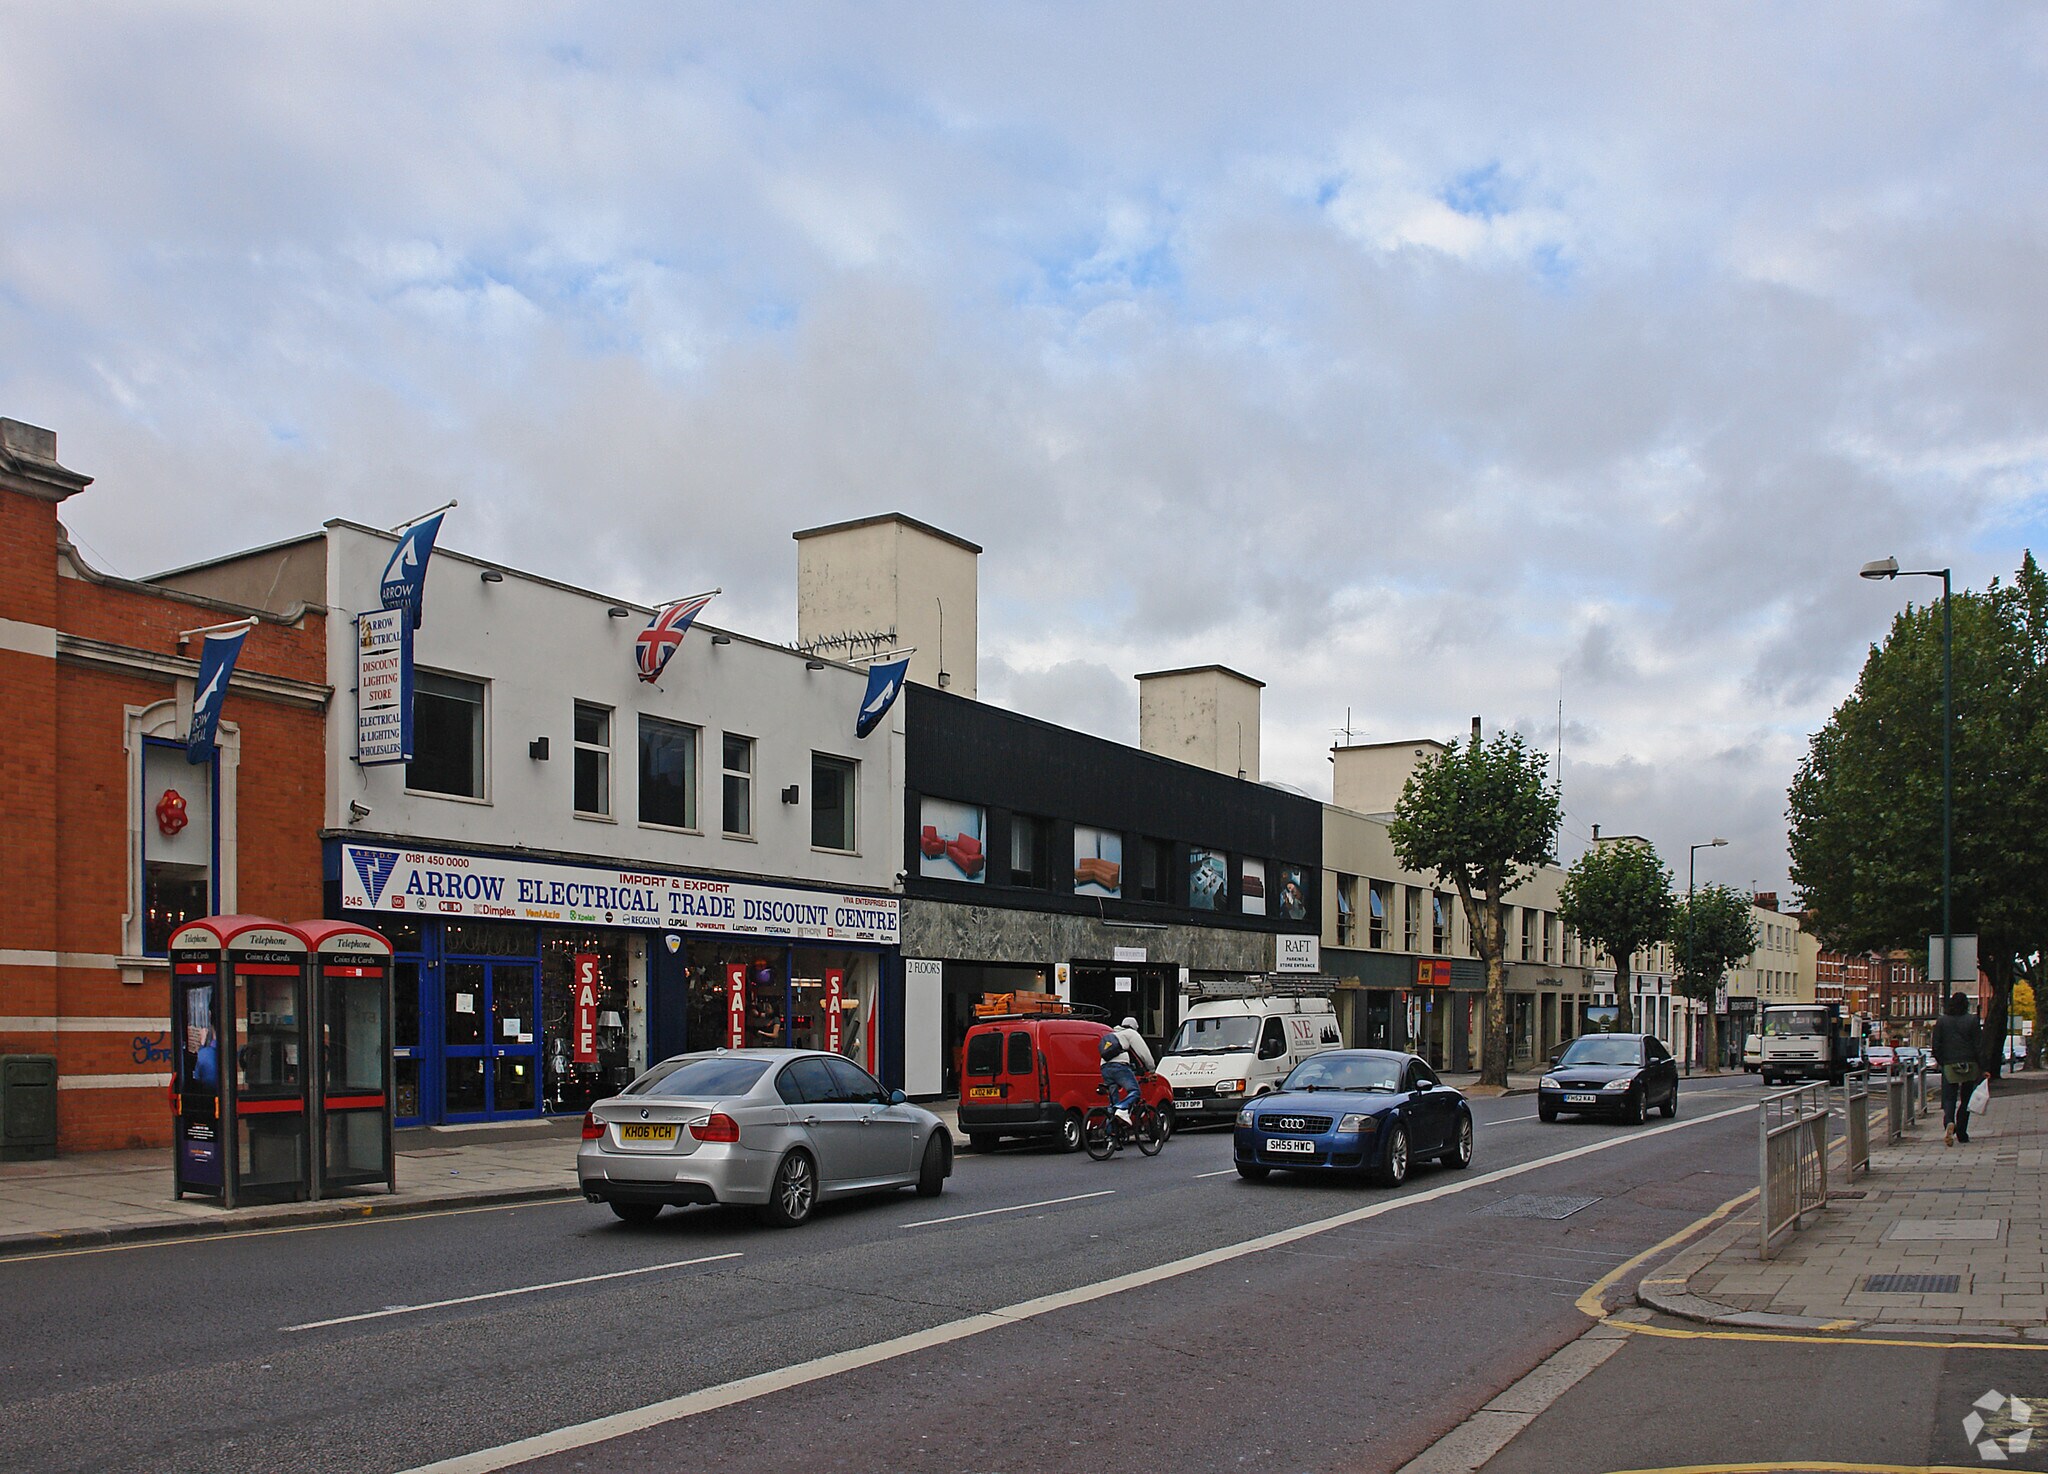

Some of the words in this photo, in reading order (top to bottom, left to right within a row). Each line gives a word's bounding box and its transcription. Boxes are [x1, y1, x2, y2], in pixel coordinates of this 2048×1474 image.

[383, 584, 414, 600] ARROW
[367, 617, 394, 630] ARROW
[360, 632, 401, 647] ELECTRICAL
[363, 658, 398, 672] DISCOUNT
[363, 673, 398, 687] LIGHTING
[369, 689, 392, 701] STORE
[360, 712, 400, 727] ELECTRICAL
[361, 732, 366, 742] &
[367, 728, 400, 742] LIGHTING
[360, 743, 401, 756] WHOLESALERS
[405, 853, 425, 864] 0181
[427, 855, 444, 865] 450
[446, 857, 469, 868] 0000
[619, 873, 667, 888] IMPORT
[671, 879, 680, 889] &
[684, 880, 730, 894] EXPORT
[344, 896, 363, 907] 245
[405, 870, 505, 901] ARROW
[517, 878, 659, 913] ELECTRICAL
[668, 892, 735, 919] TRADE
[743, 899, 828, 926] DISCOUNT
[835, 907, 897, 931] CENTRE
[842, 896, 855, 904] VIVA
[855, 897, 888, 908] ENTERPRISES
[888, 900, 897, 908] LTD
[483, 904, 516, 917] Dimplex
[631, 915, 661, 926] REGGIANI
[696, 922, 726, 930] POWERLITE
[732, 923, 758, 933] Lumiance
[184, 934, 208, 945] Telephone
[250, 935, 287, 946] Telephone
[337, 938, 371, 949] Telephone
[1285, 940, 1311, 952] RAFT
[245, 952, 263, 961] Coins
[264, 953, 271, 961] &
[271, 953, 290, 962] Cards
[333, 955, 350, 964] Coins
[350, 956, 357, 964] &
[357, 956, 375, 965] Cards
[908, 961, 913, 973] 2
[914, 962, 941, 974] FLOORS
[580, 962, 595, 1053] SALE
[731, 971, 744, 1049] SALE
[829, 976, 841, 1052] SALE
[250, 1011, 272, 1024] BT
[1291, 1020, 1314, 1039] NE
[1172, 1062, 1219, 1072] NE
[624, 1125, 650, 1138] KH06
[652, 1126, 672, 1138] YCH
[1270, 1140, 1292, 1150] SH55
[1294, 1141, 1311, 1151] HWC
